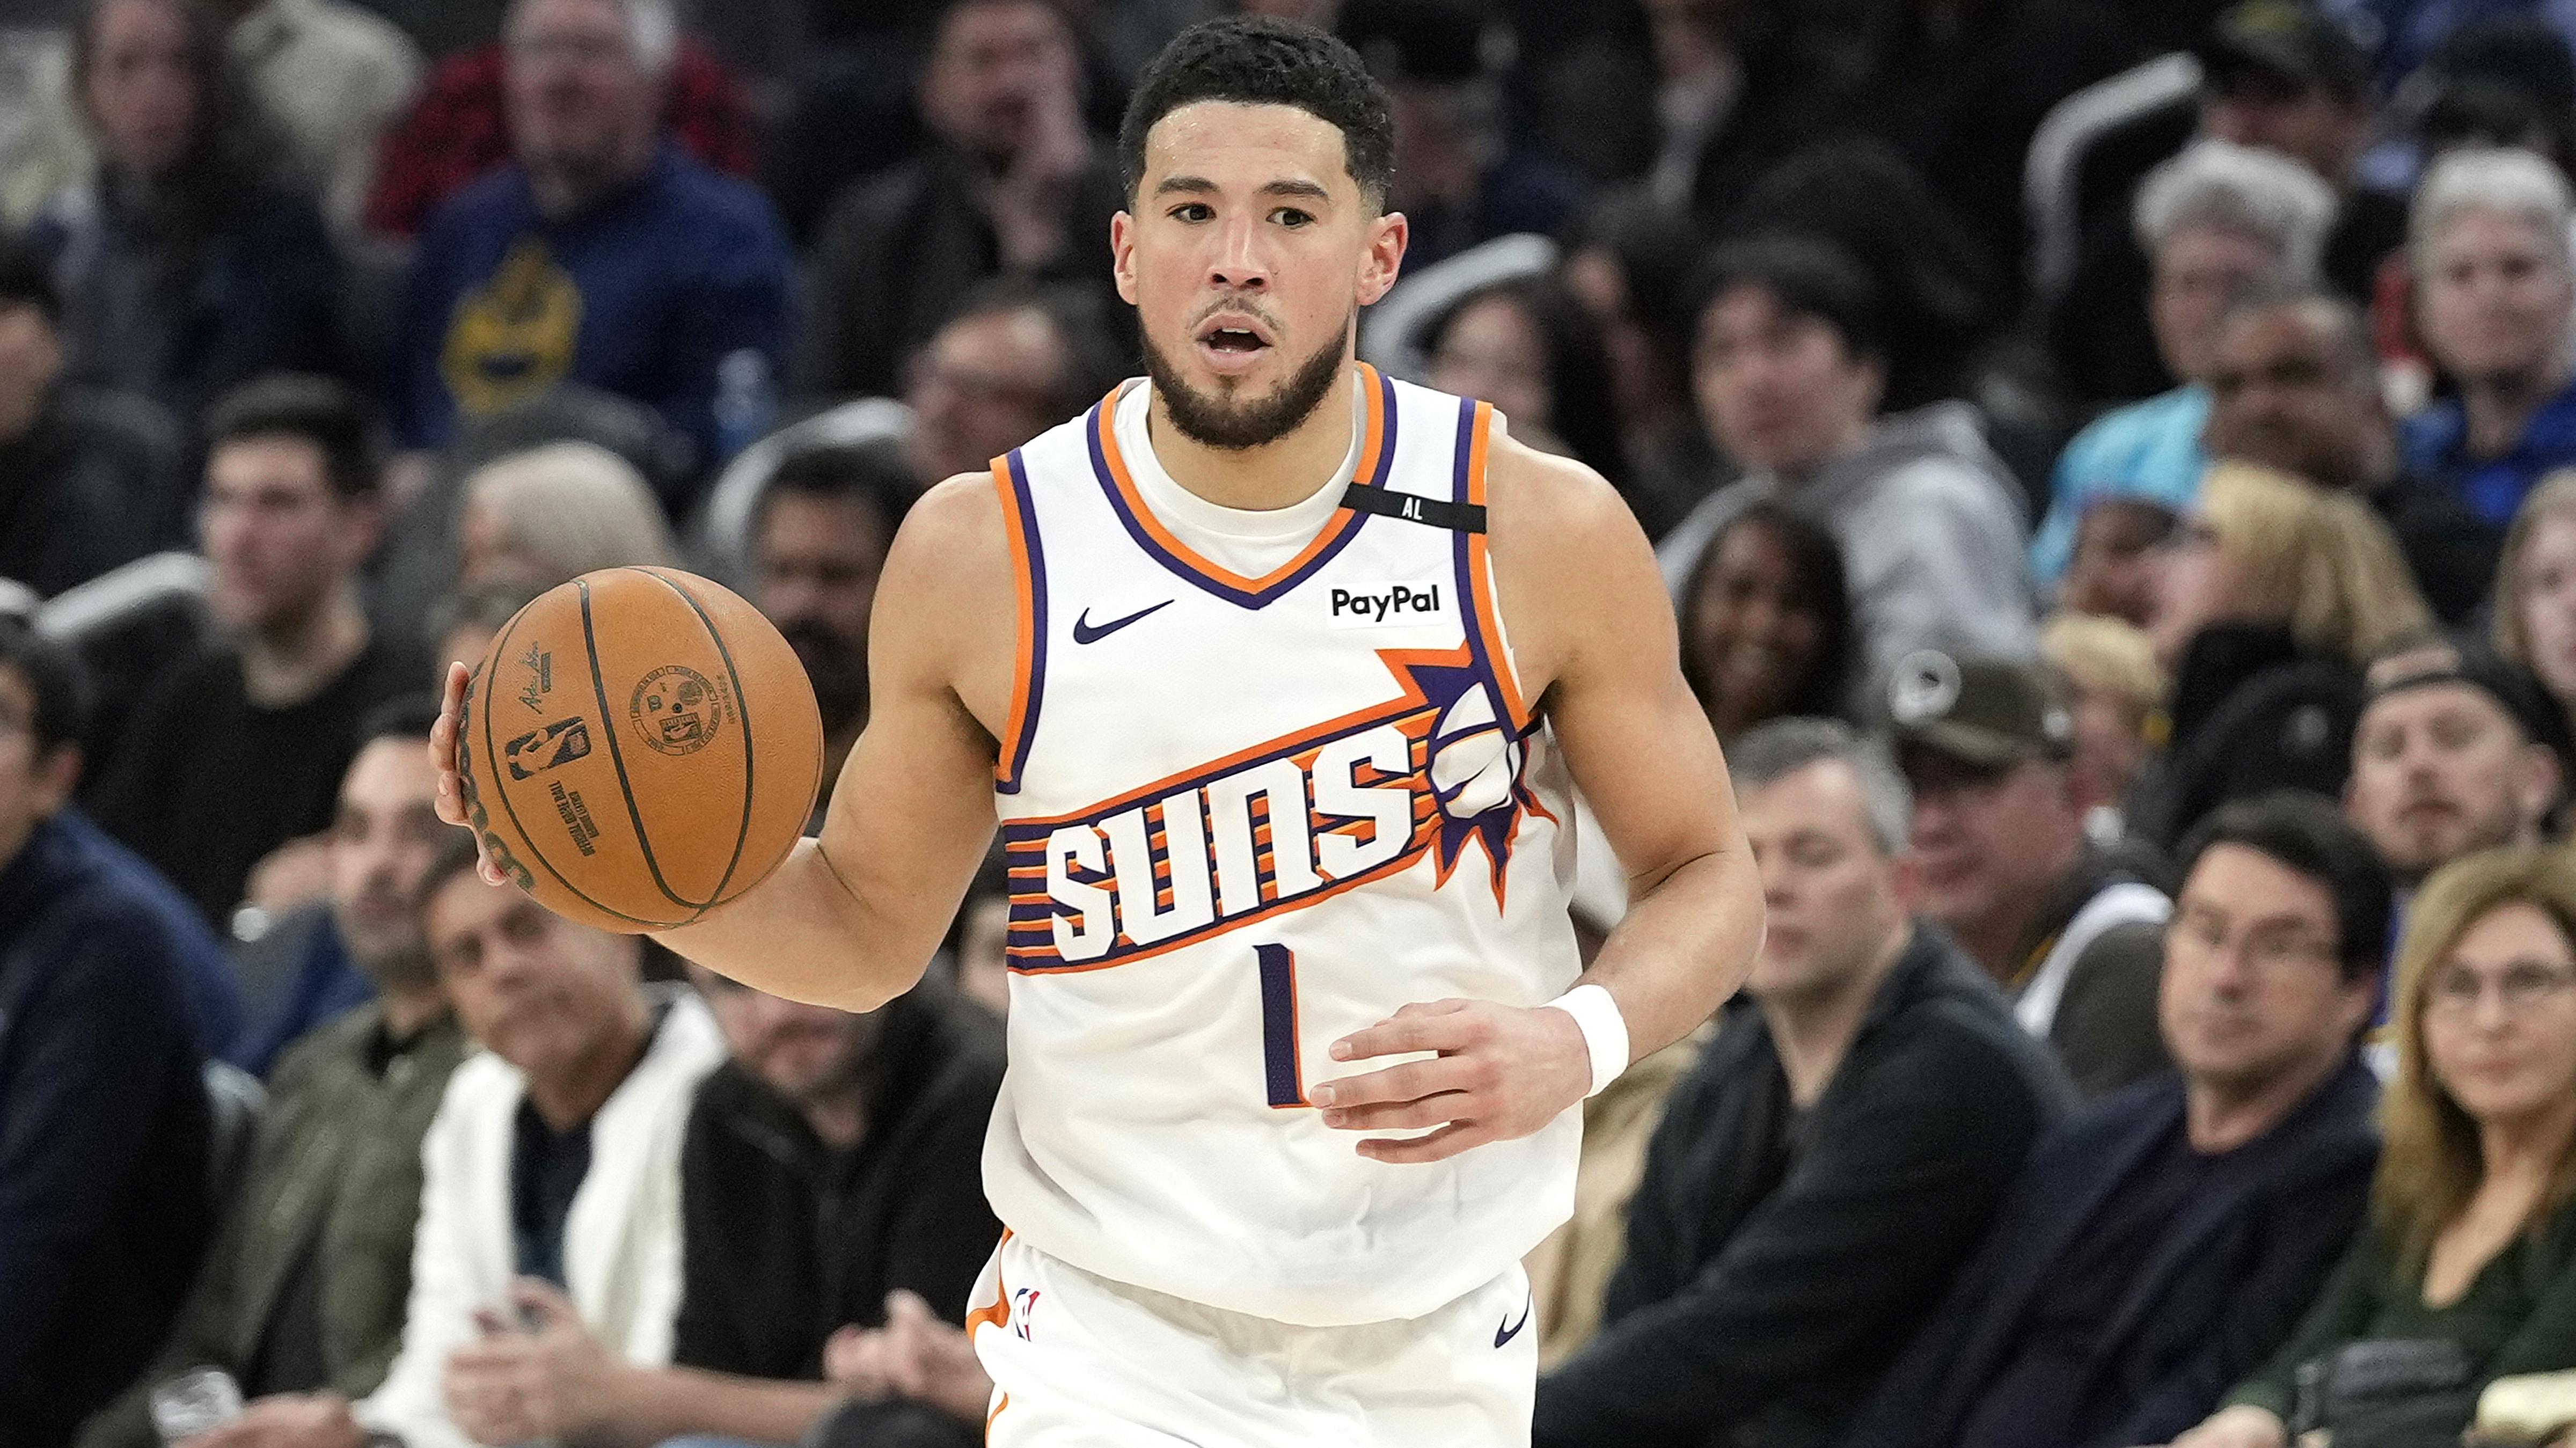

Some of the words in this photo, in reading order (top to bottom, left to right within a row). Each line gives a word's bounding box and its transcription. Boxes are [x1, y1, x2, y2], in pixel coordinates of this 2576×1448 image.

[1401, 496, 1423, 520] AL
[1331, 584, 1440, 623] PayPal
[1252, 942, 1309, 1108] 1
